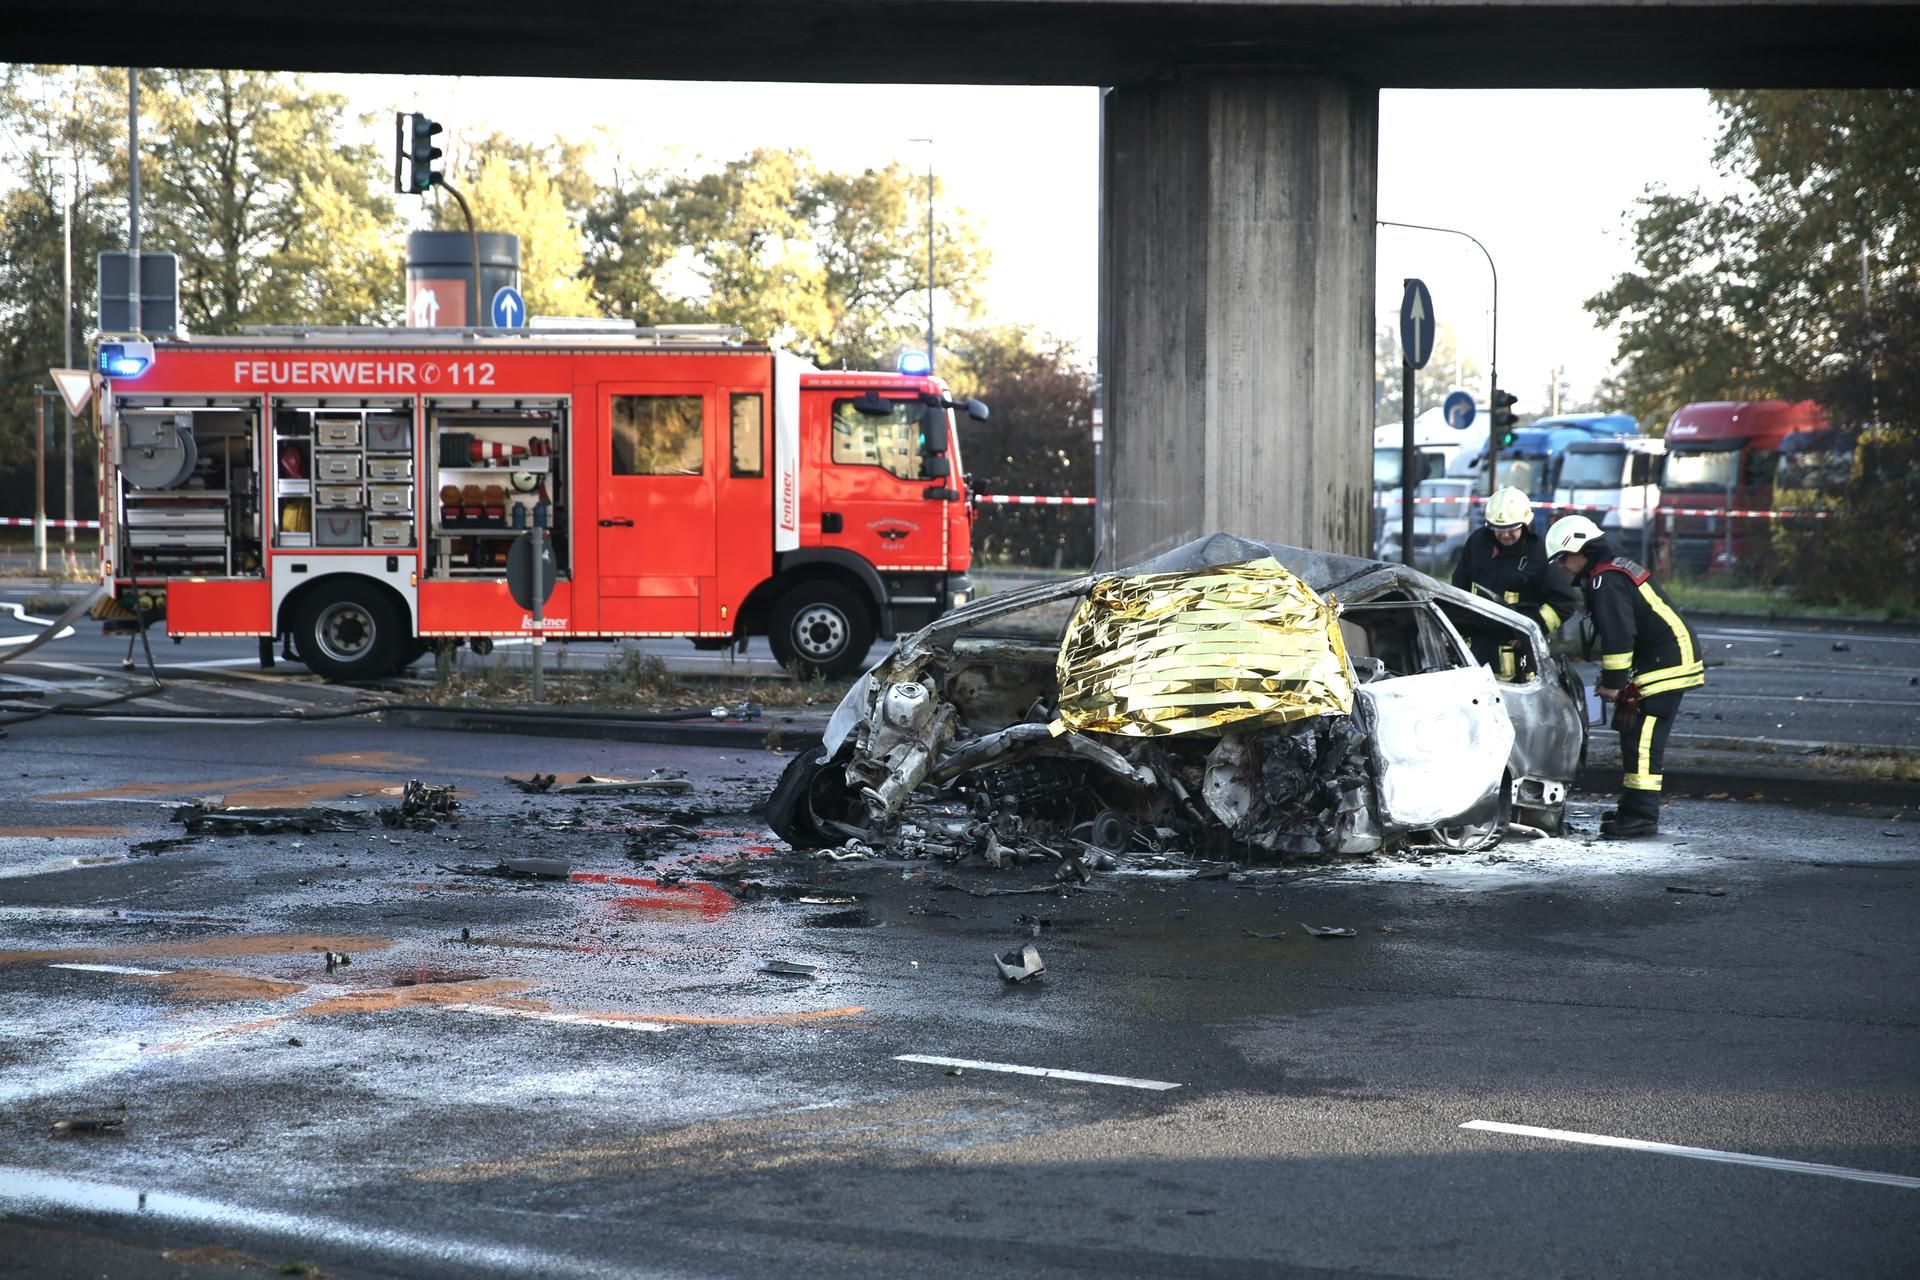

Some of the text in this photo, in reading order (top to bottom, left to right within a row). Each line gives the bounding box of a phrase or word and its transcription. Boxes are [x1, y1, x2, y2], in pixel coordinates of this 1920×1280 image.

[234, 362, 496, 385] FEUERWEHR 112
[521, 614, 568, 629] Letner
